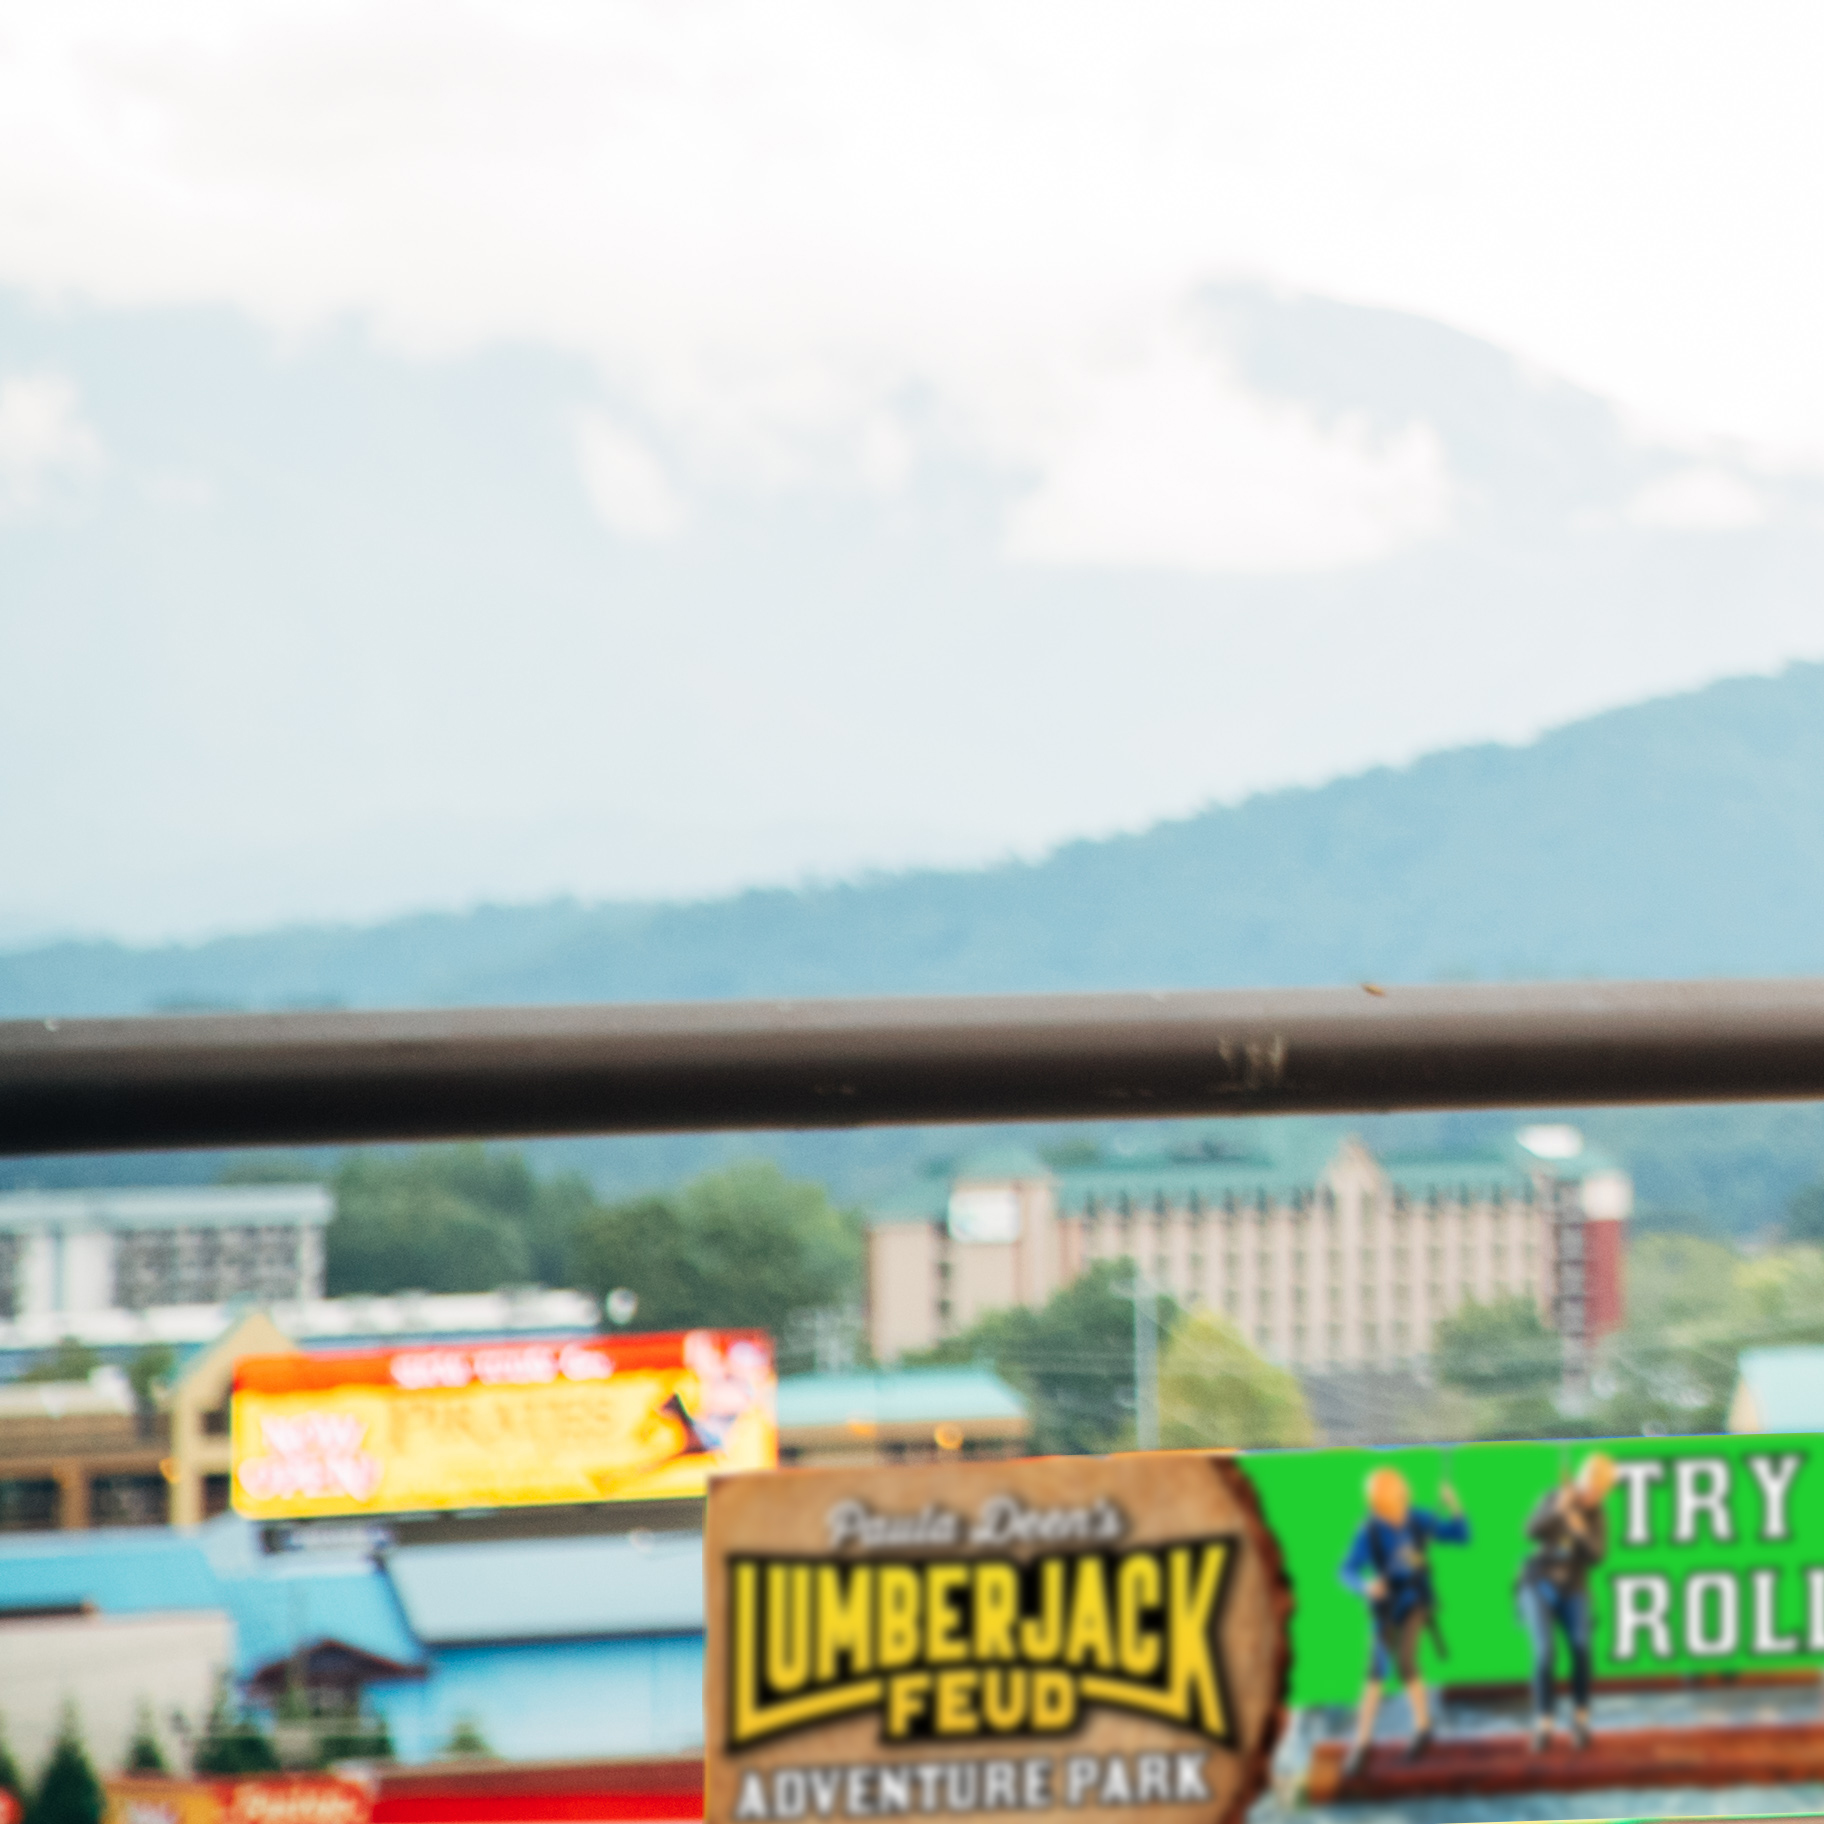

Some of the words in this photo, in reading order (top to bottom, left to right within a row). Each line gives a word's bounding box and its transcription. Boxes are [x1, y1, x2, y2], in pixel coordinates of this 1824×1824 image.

[829, 1500, 958, 1547] Paula
[969, 1493, 1123, 1545] Deen's
[1614, 1454, 1802, 1545] TRY
[735, 1543, 1227, 1741] LUMBERJACK
[888, 1669, 1077, 1736] FEUD
[737, 1760, 1051, 1819] ADVENTURE
[1068, 1753, 1209, 1807] PARK
